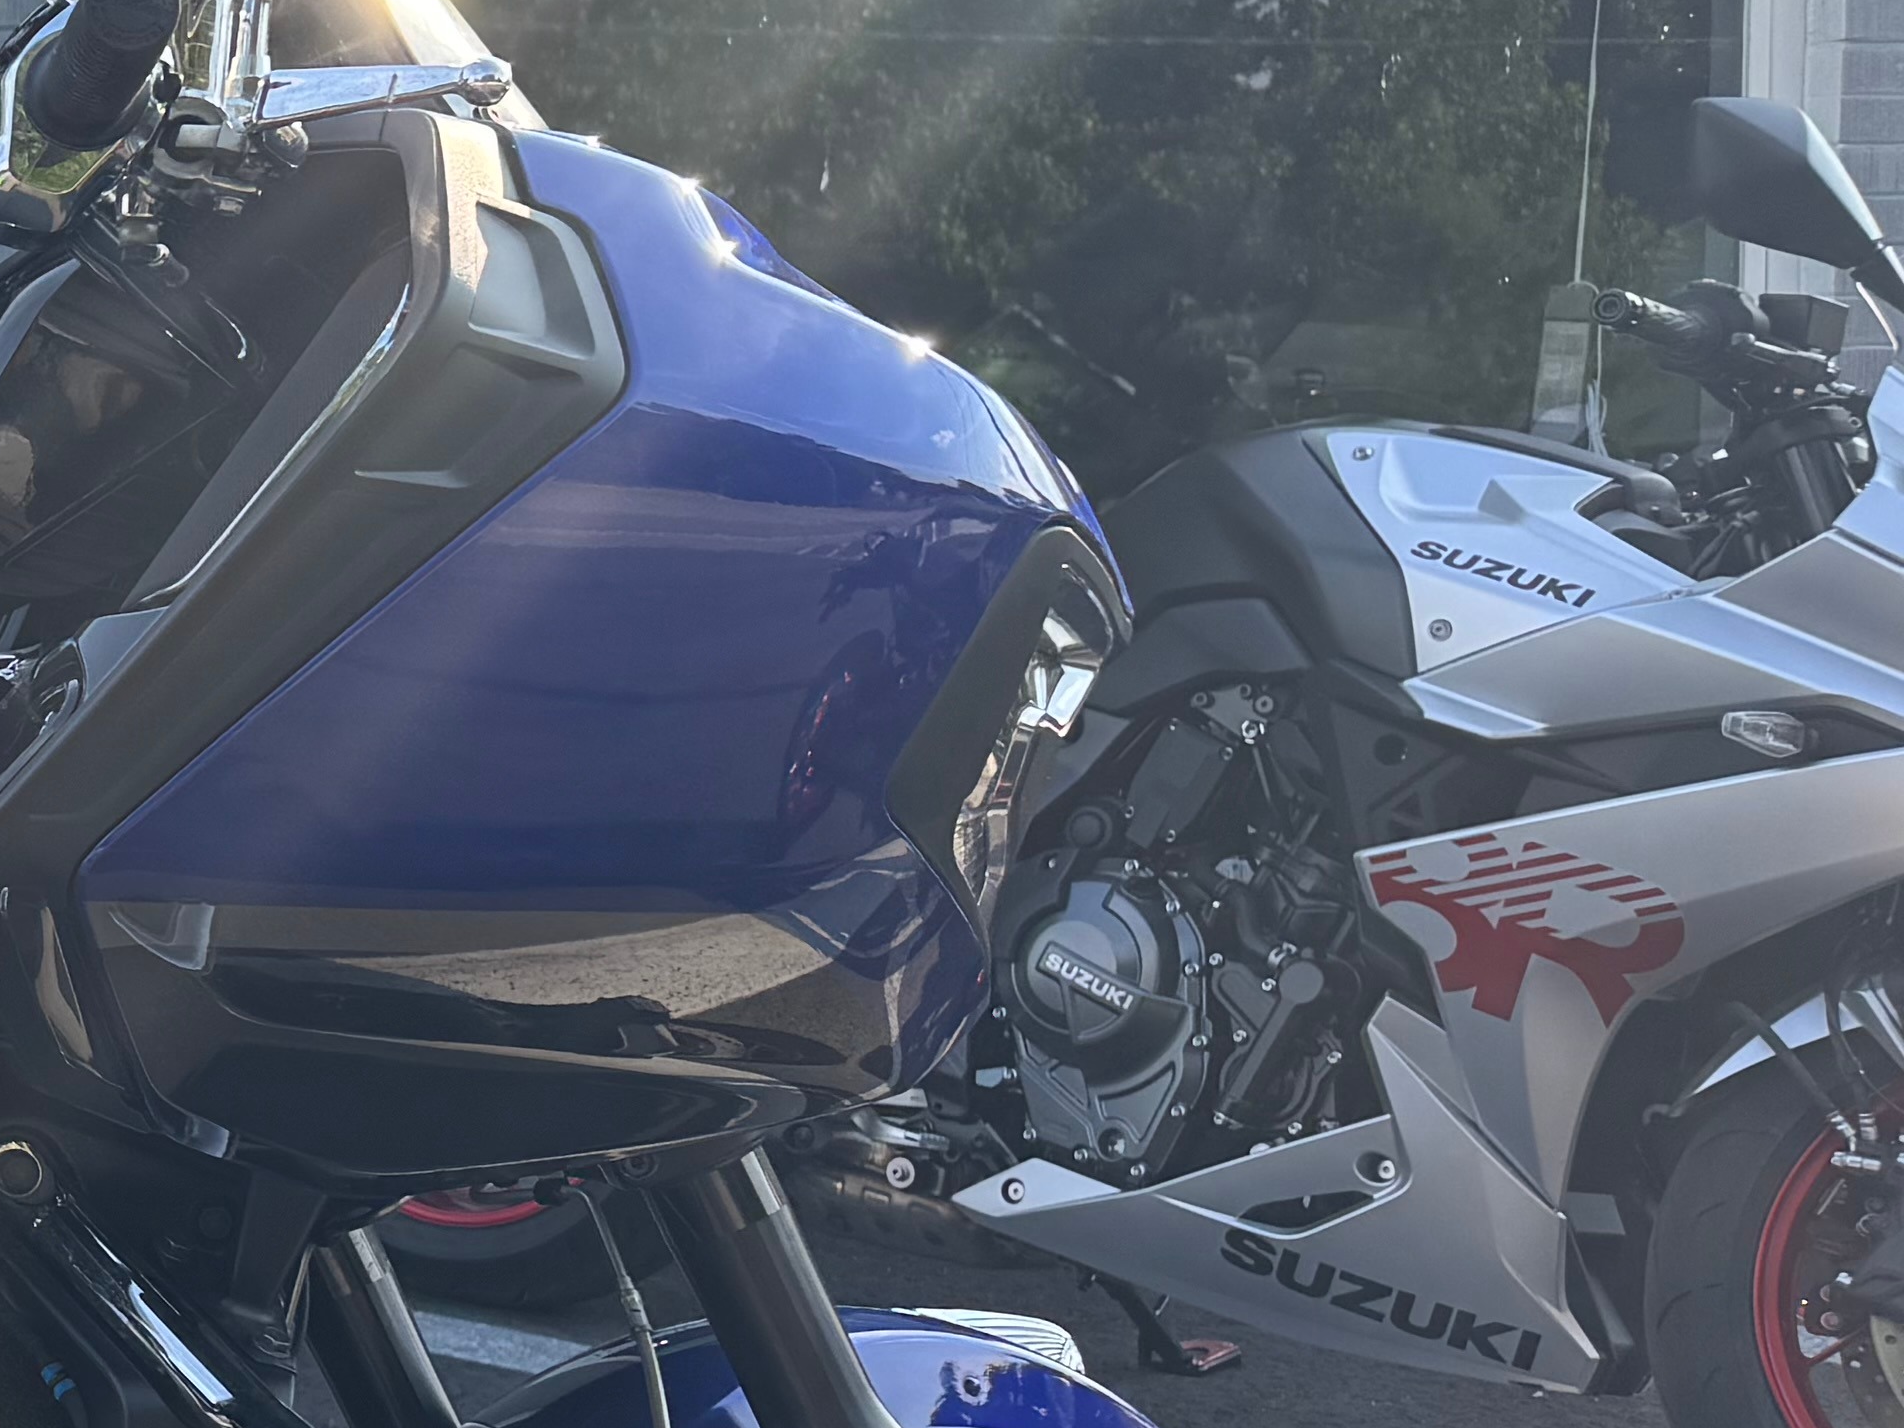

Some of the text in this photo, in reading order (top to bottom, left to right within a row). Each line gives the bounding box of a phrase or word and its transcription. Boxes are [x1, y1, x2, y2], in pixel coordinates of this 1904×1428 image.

[1410, 538, 1595, 610] SUZUKI
[1044, 951, 1135, 1011] SUZUKI
[1220, 1229, 1543, 1371] SUZUKI
